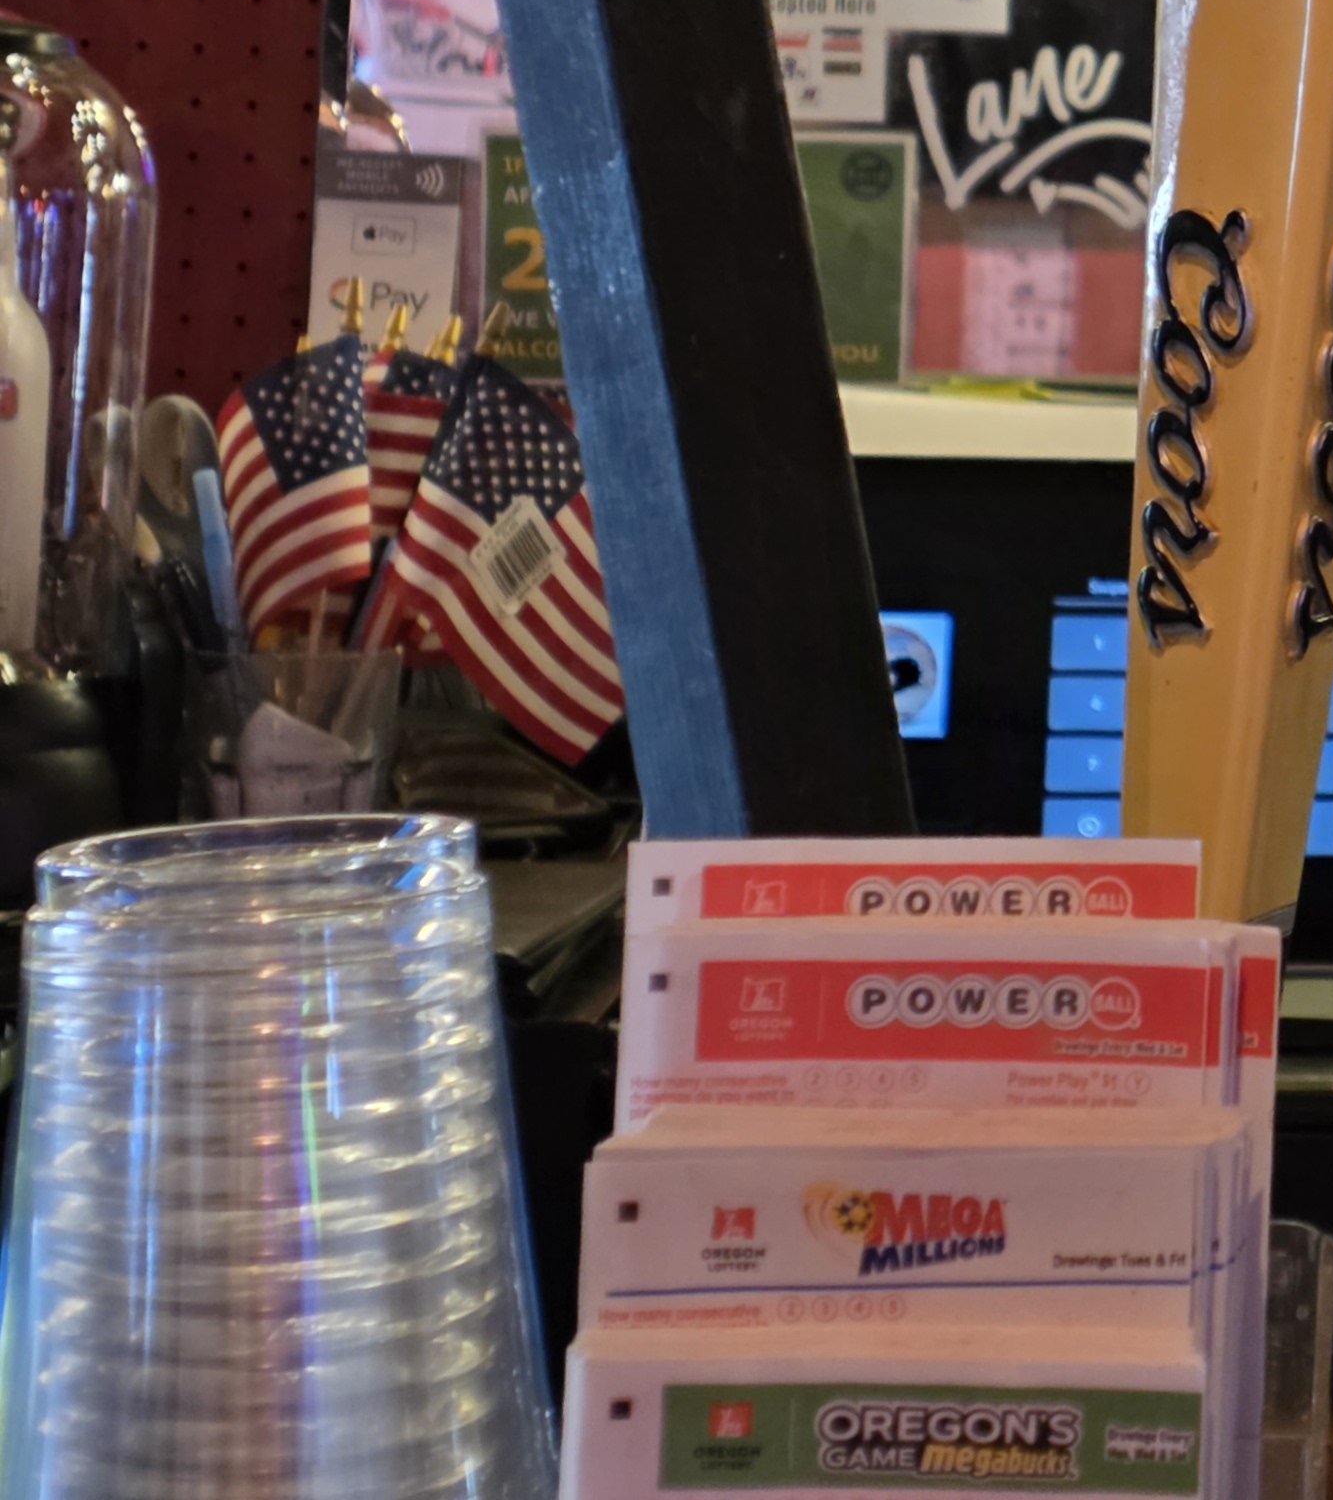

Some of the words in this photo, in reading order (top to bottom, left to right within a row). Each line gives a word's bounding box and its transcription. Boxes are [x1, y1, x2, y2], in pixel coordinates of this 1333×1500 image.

[908, 43, 1123, 211] Lame
[502, 226, 548, 291] 2
[369, 281, 430, 320] Pay
[1138, 209, 1252, 652] Coors
[857, 889, 1073, 917] POWER
[861, 987, 1081, 1016] POWER
[869, 1191, 1007, 1246] MEGA
[857, 1233, 1006, 1278] MILLIONS
[820, 1406, 1079, 1445] OREGON'S
[822, 1446, 916, 1471] GAME
[919, 1441, 1074, 1478] megabucks
